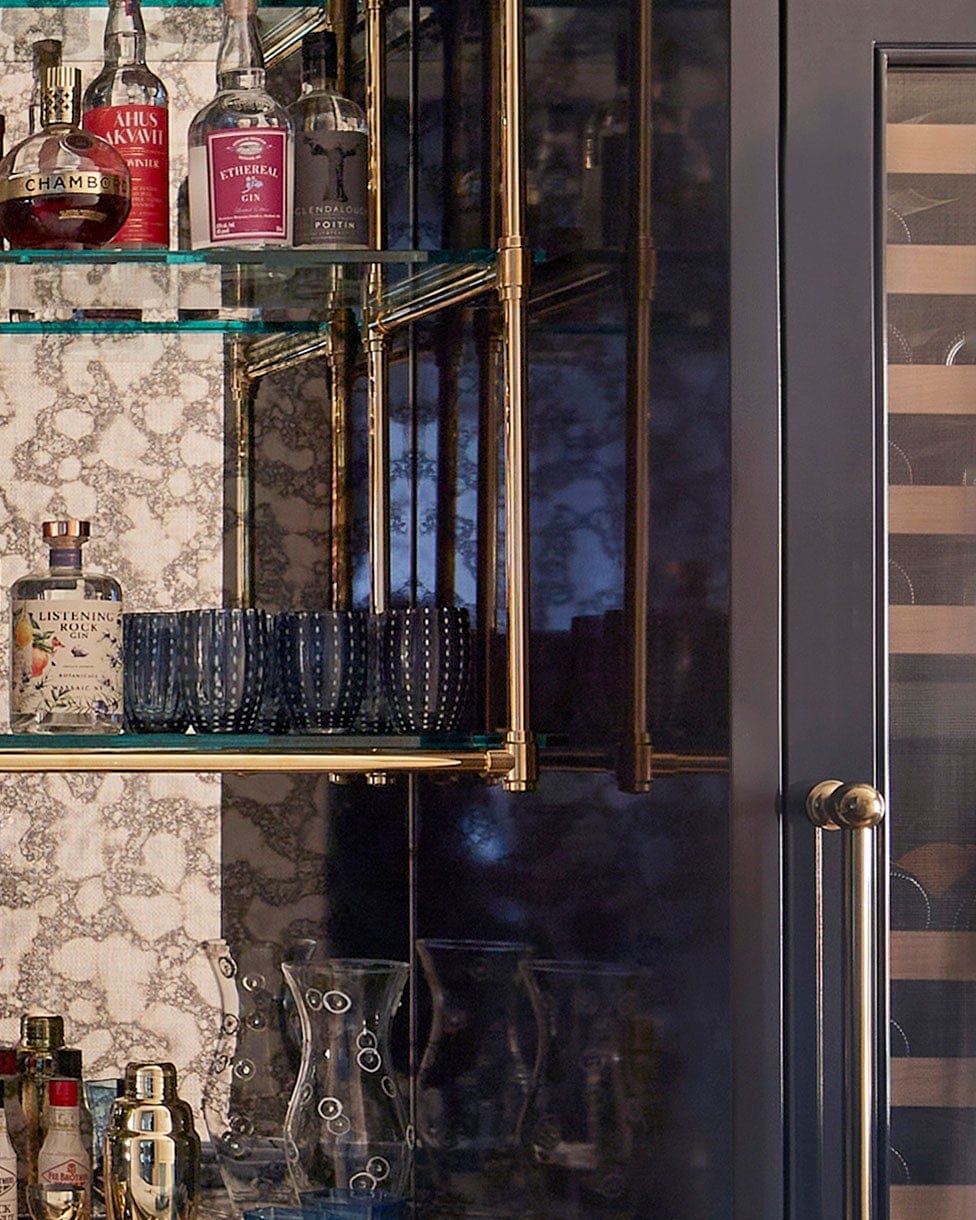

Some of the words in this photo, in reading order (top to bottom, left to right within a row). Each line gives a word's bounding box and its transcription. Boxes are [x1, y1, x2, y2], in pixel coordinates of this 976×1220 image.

[219, 164, 279, 181] ETHEREAL
[241, 193, 261, 202] GIN
[295, 205, 368, 215] GLENDALOUG
[39, 611, 114, 621] LISTENING
[60, 623, 99, 632] ROCK
[69, 631, 89, 639] GIN
